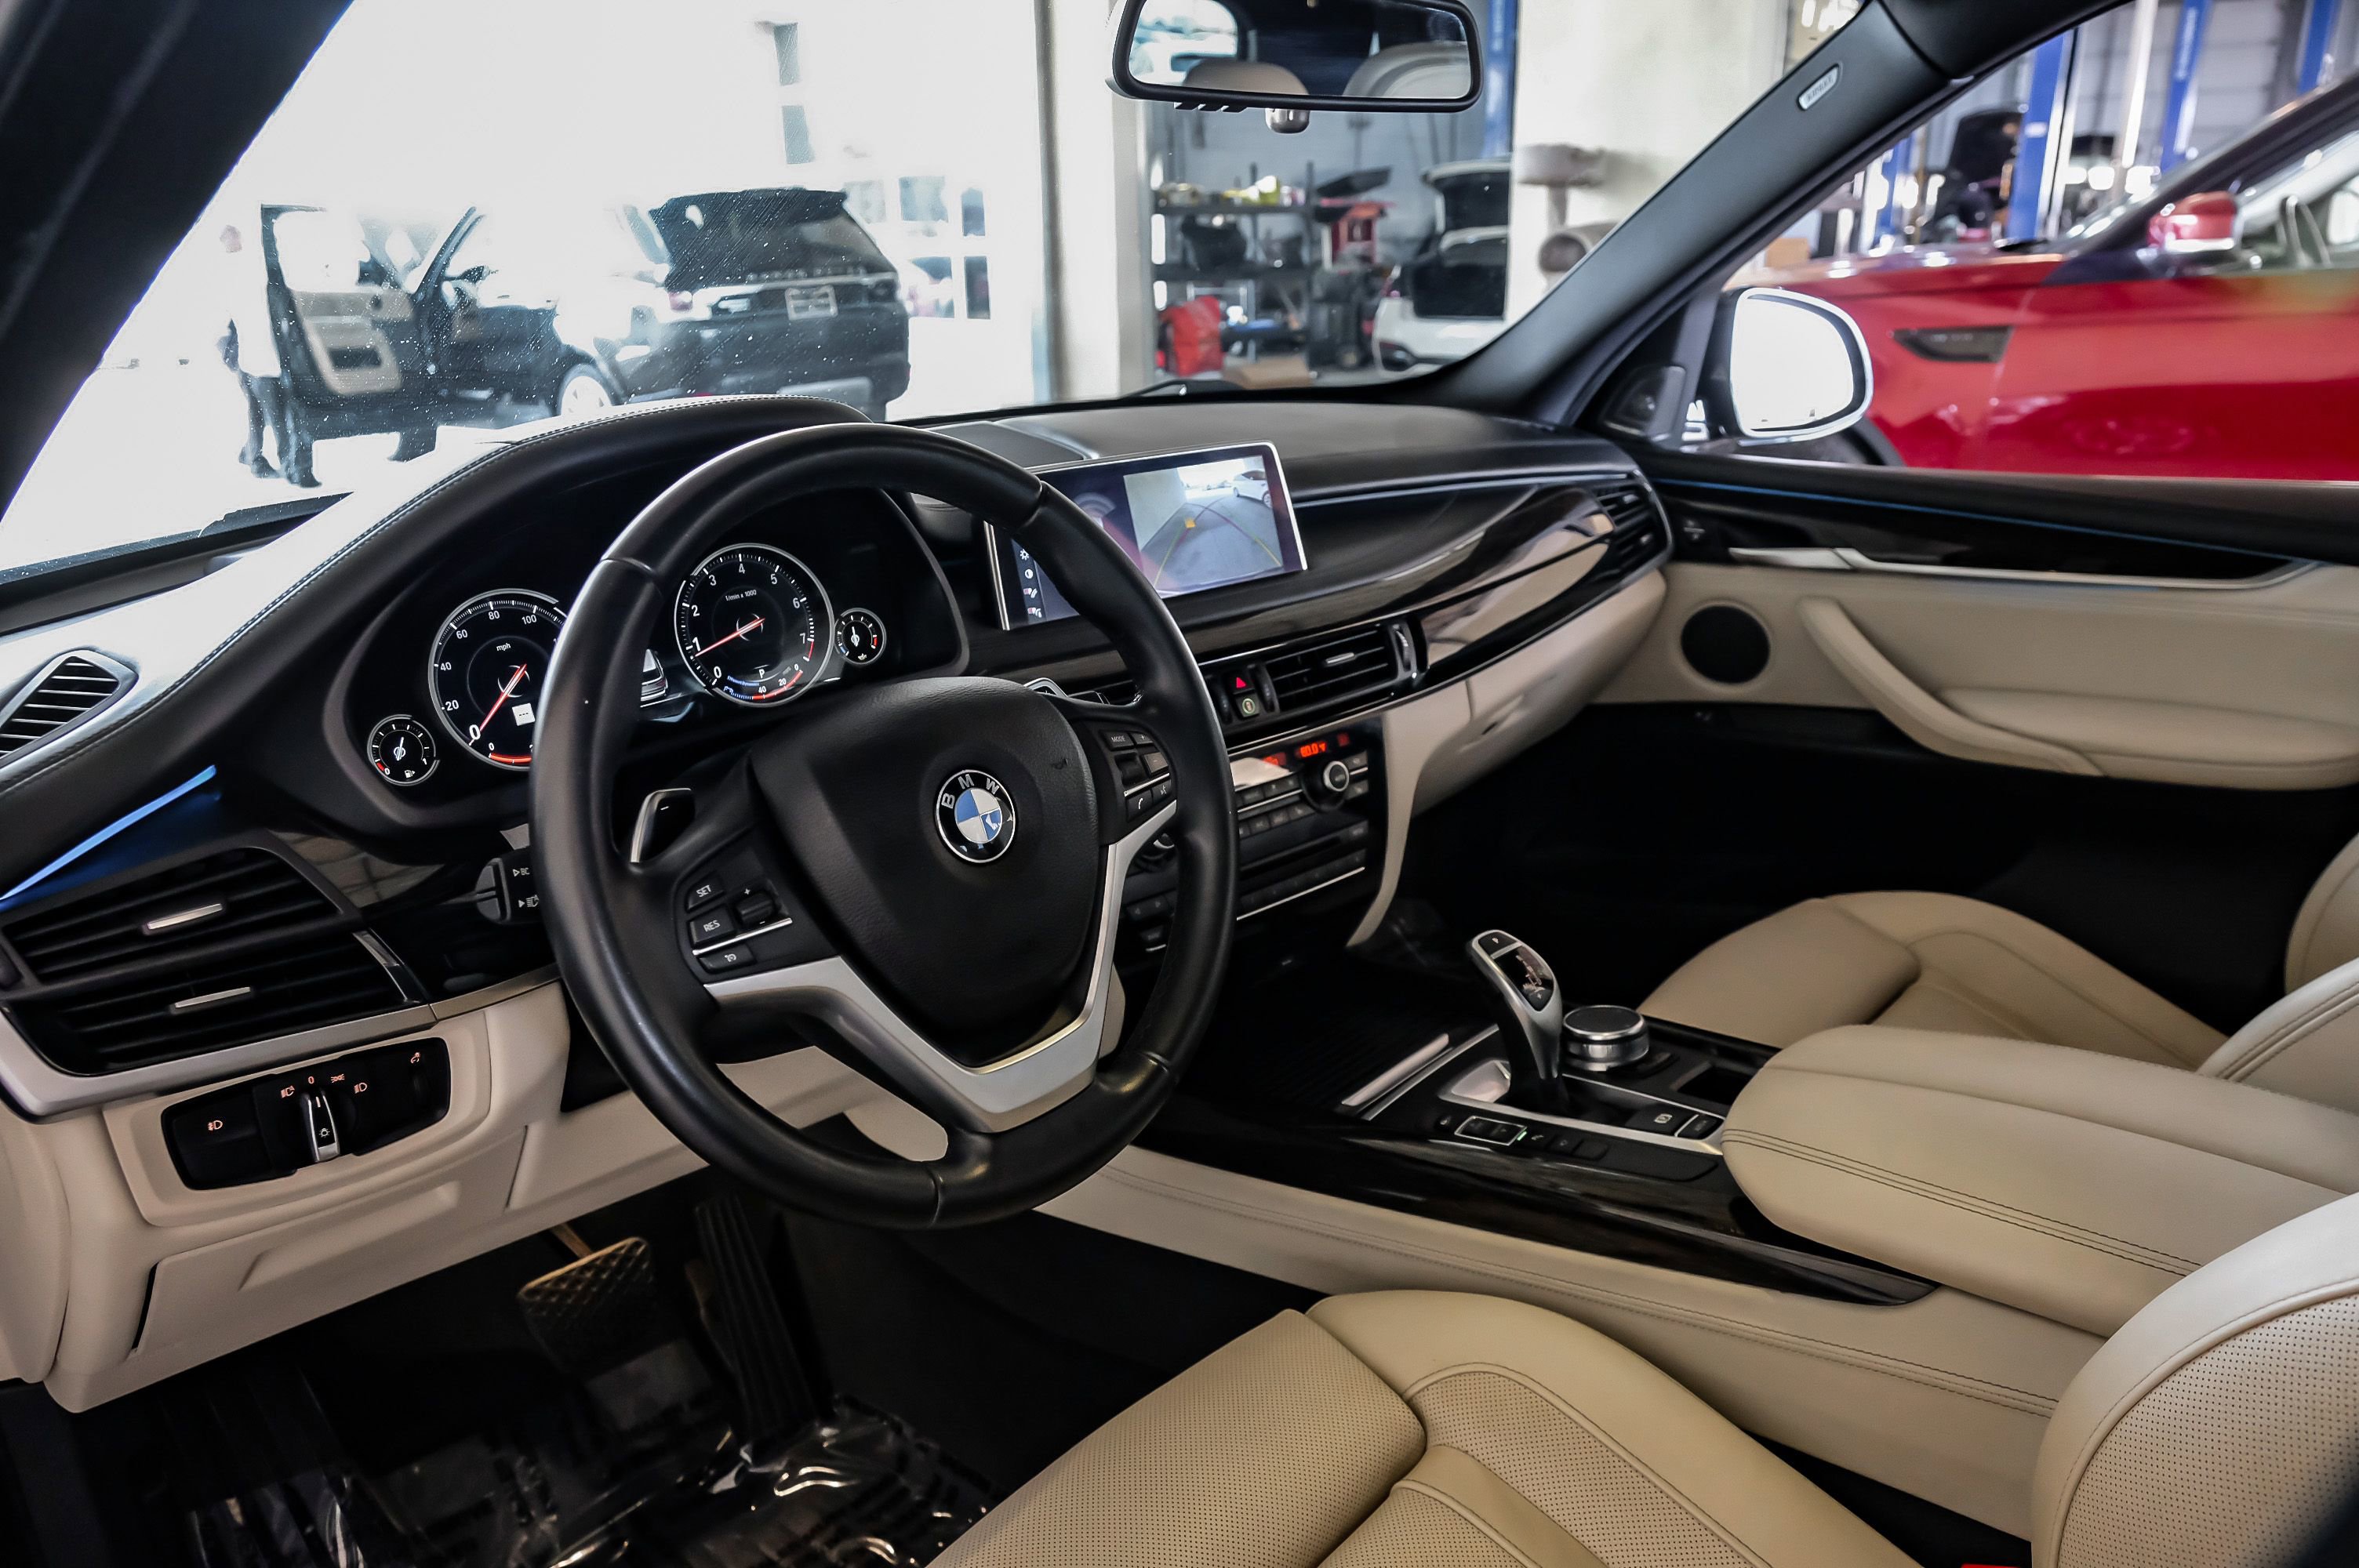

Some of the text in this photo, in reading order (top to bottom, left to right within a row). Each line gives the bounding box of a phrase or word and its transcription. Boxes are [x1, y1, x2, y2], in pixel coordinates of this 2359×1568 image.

[738, 564, 745, 574] 4
[709, 574, 717, 586] 3
[770, 574, 778, 585] 5
[792, 597, 800, 608] 6
[488, 610, 500, 621] 80
[692, 604, 700, 617] 2
[522, 614, 537, 626] 100
[456, 629, 468, 640] 60
[799, 633, 806, 644] 7
[496, 642, 511, 652] mph
[692, 637, 701, 652] 1
[440, 662, 452, 672] 40
[713, 666, 722, 679] 0
[794, 663, 800, 672] 0
[758, 669, 765, 679] P
[778, 677, 787, 687] 20
[758, 685, 767, 694] 40
[445, 699, 460, 711] 20
[469, 724, 481, 741] 0
[488, 742, 495, 752] 0
[384, 767, 391, 776] 0
[941, 773, 1001, 809] BMW
[520, 867, 530, 876] BC
[696, 884, 712, 898] SET
[703, 919, 721, 933] RES
[307, 1076, 314, 1084] 0
